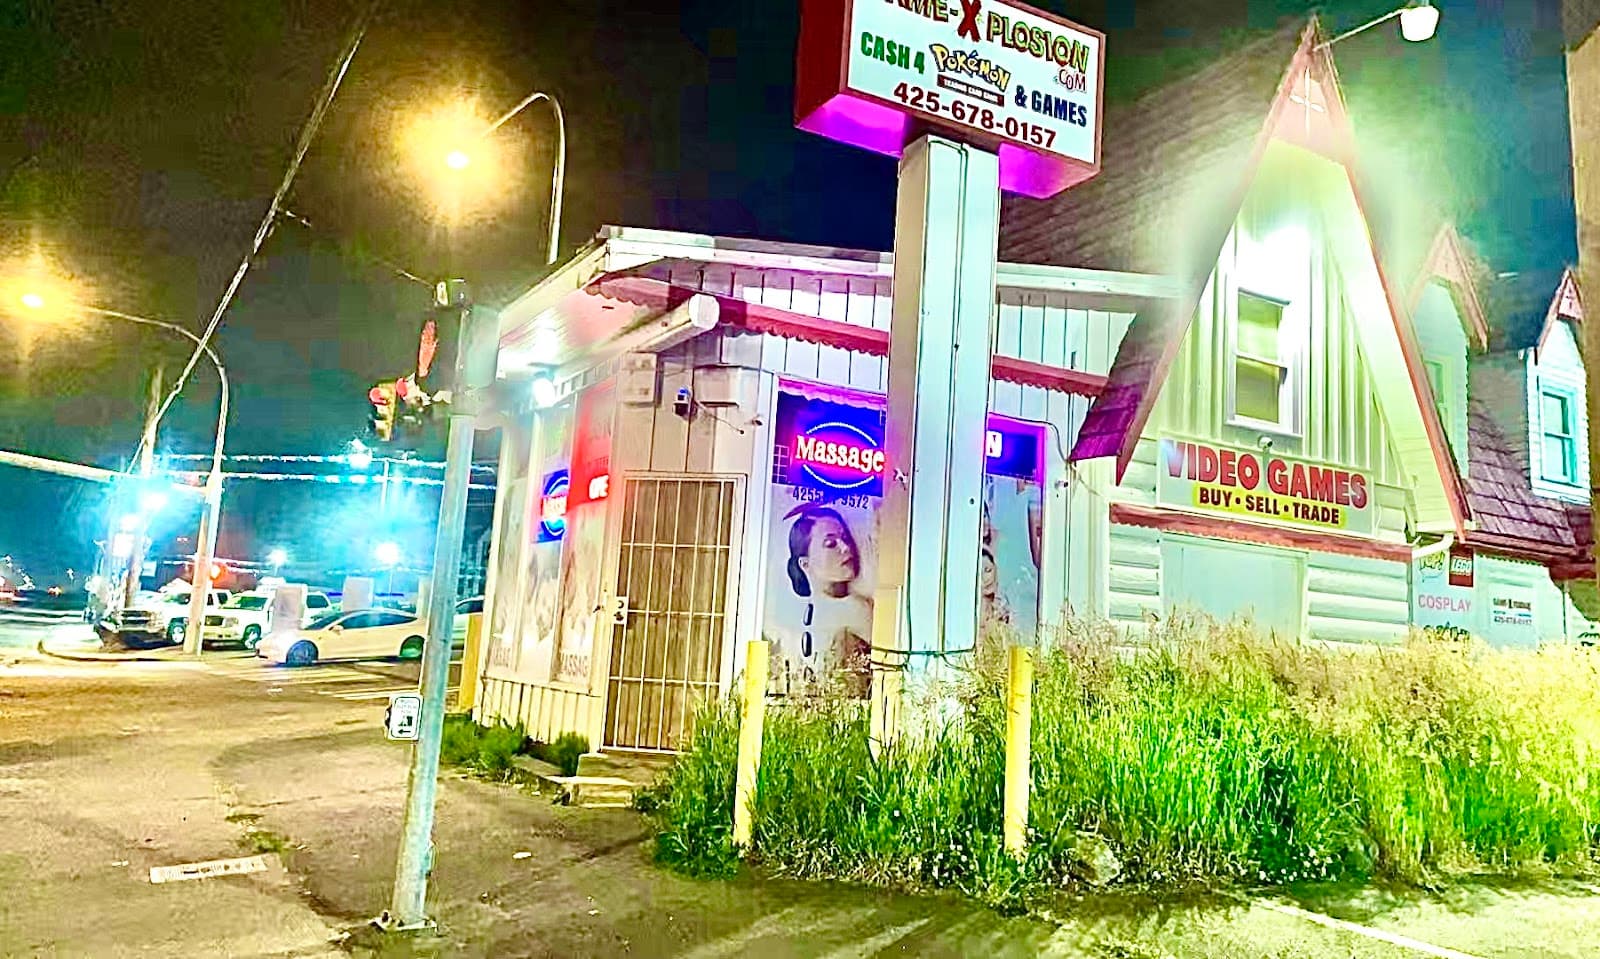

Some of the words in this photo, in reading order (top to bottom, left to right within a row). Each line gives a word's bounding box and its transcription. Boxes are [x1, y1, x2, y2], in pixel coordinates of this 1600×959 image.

[861, 31, 910, 69] CASH
[914, 51, 925, 75] 4
[1015, 85, 1028, 107] &
[1031, 91, 1087, 127] GAMES
[893, 83, 1057, 149] 425-678-0157
[796, 435, 885, 474] Massage
[1161, 439, 1260, 490] VIDEO
[1267, 459, 1368, 510] GAMES
[1199, 487, 1233, 508] BUY
[1246, 494, 1280, 515] SELL
[1293, 502, 1340, 525] TRADE
[1418, 594, 1472, 612] COSPLAY
